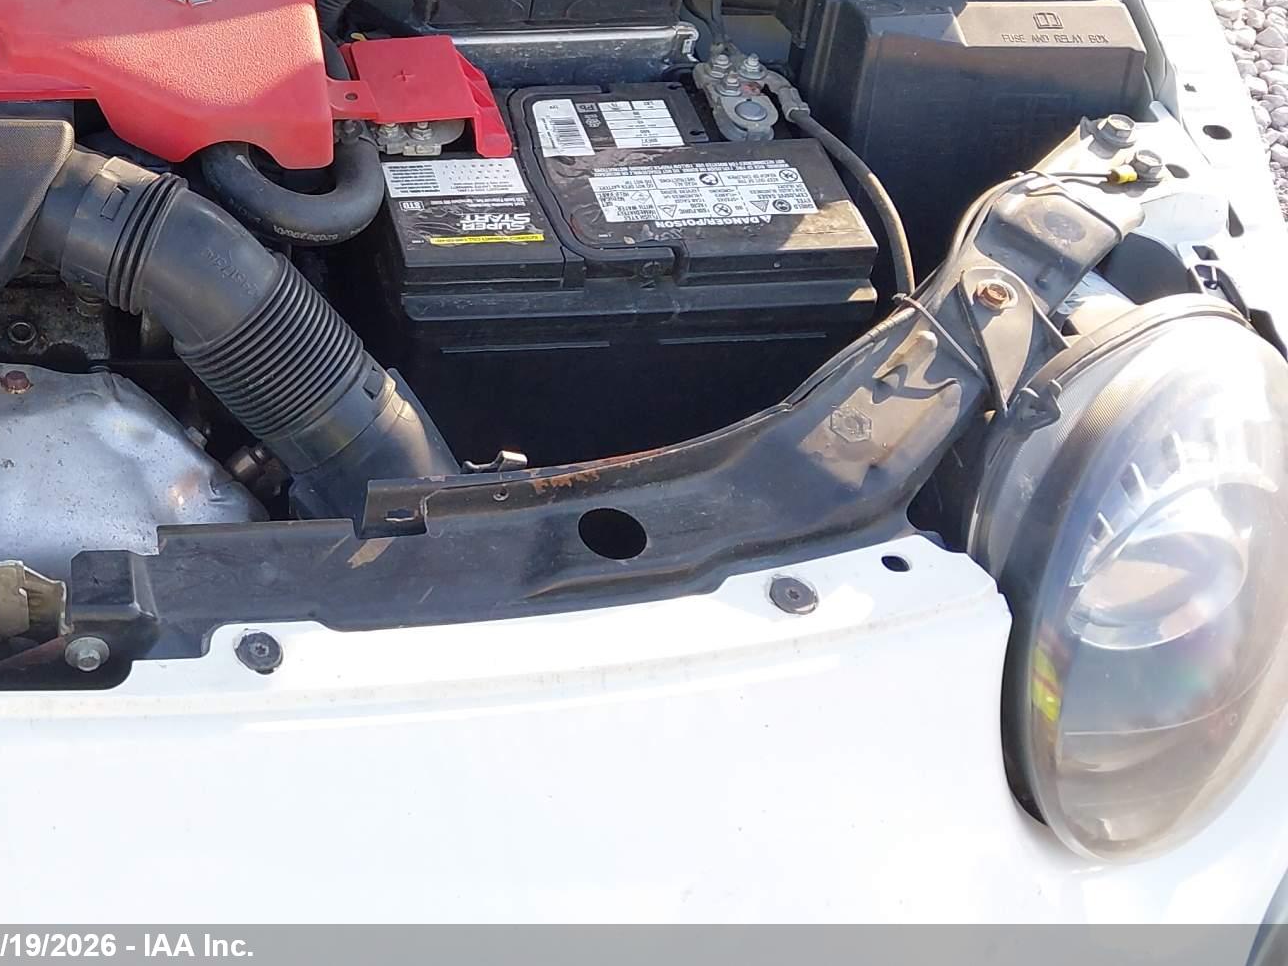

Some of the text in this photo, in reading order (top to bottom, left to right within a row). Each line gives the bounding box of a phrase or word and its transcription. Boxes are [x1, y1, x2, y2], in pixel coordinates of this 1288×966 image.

[1001, 34, 1110, 44] FUSE AND RELAY BOX
[460, 213, 531, 224] START
[655, 216, 761, 228] DANGER/POISON
